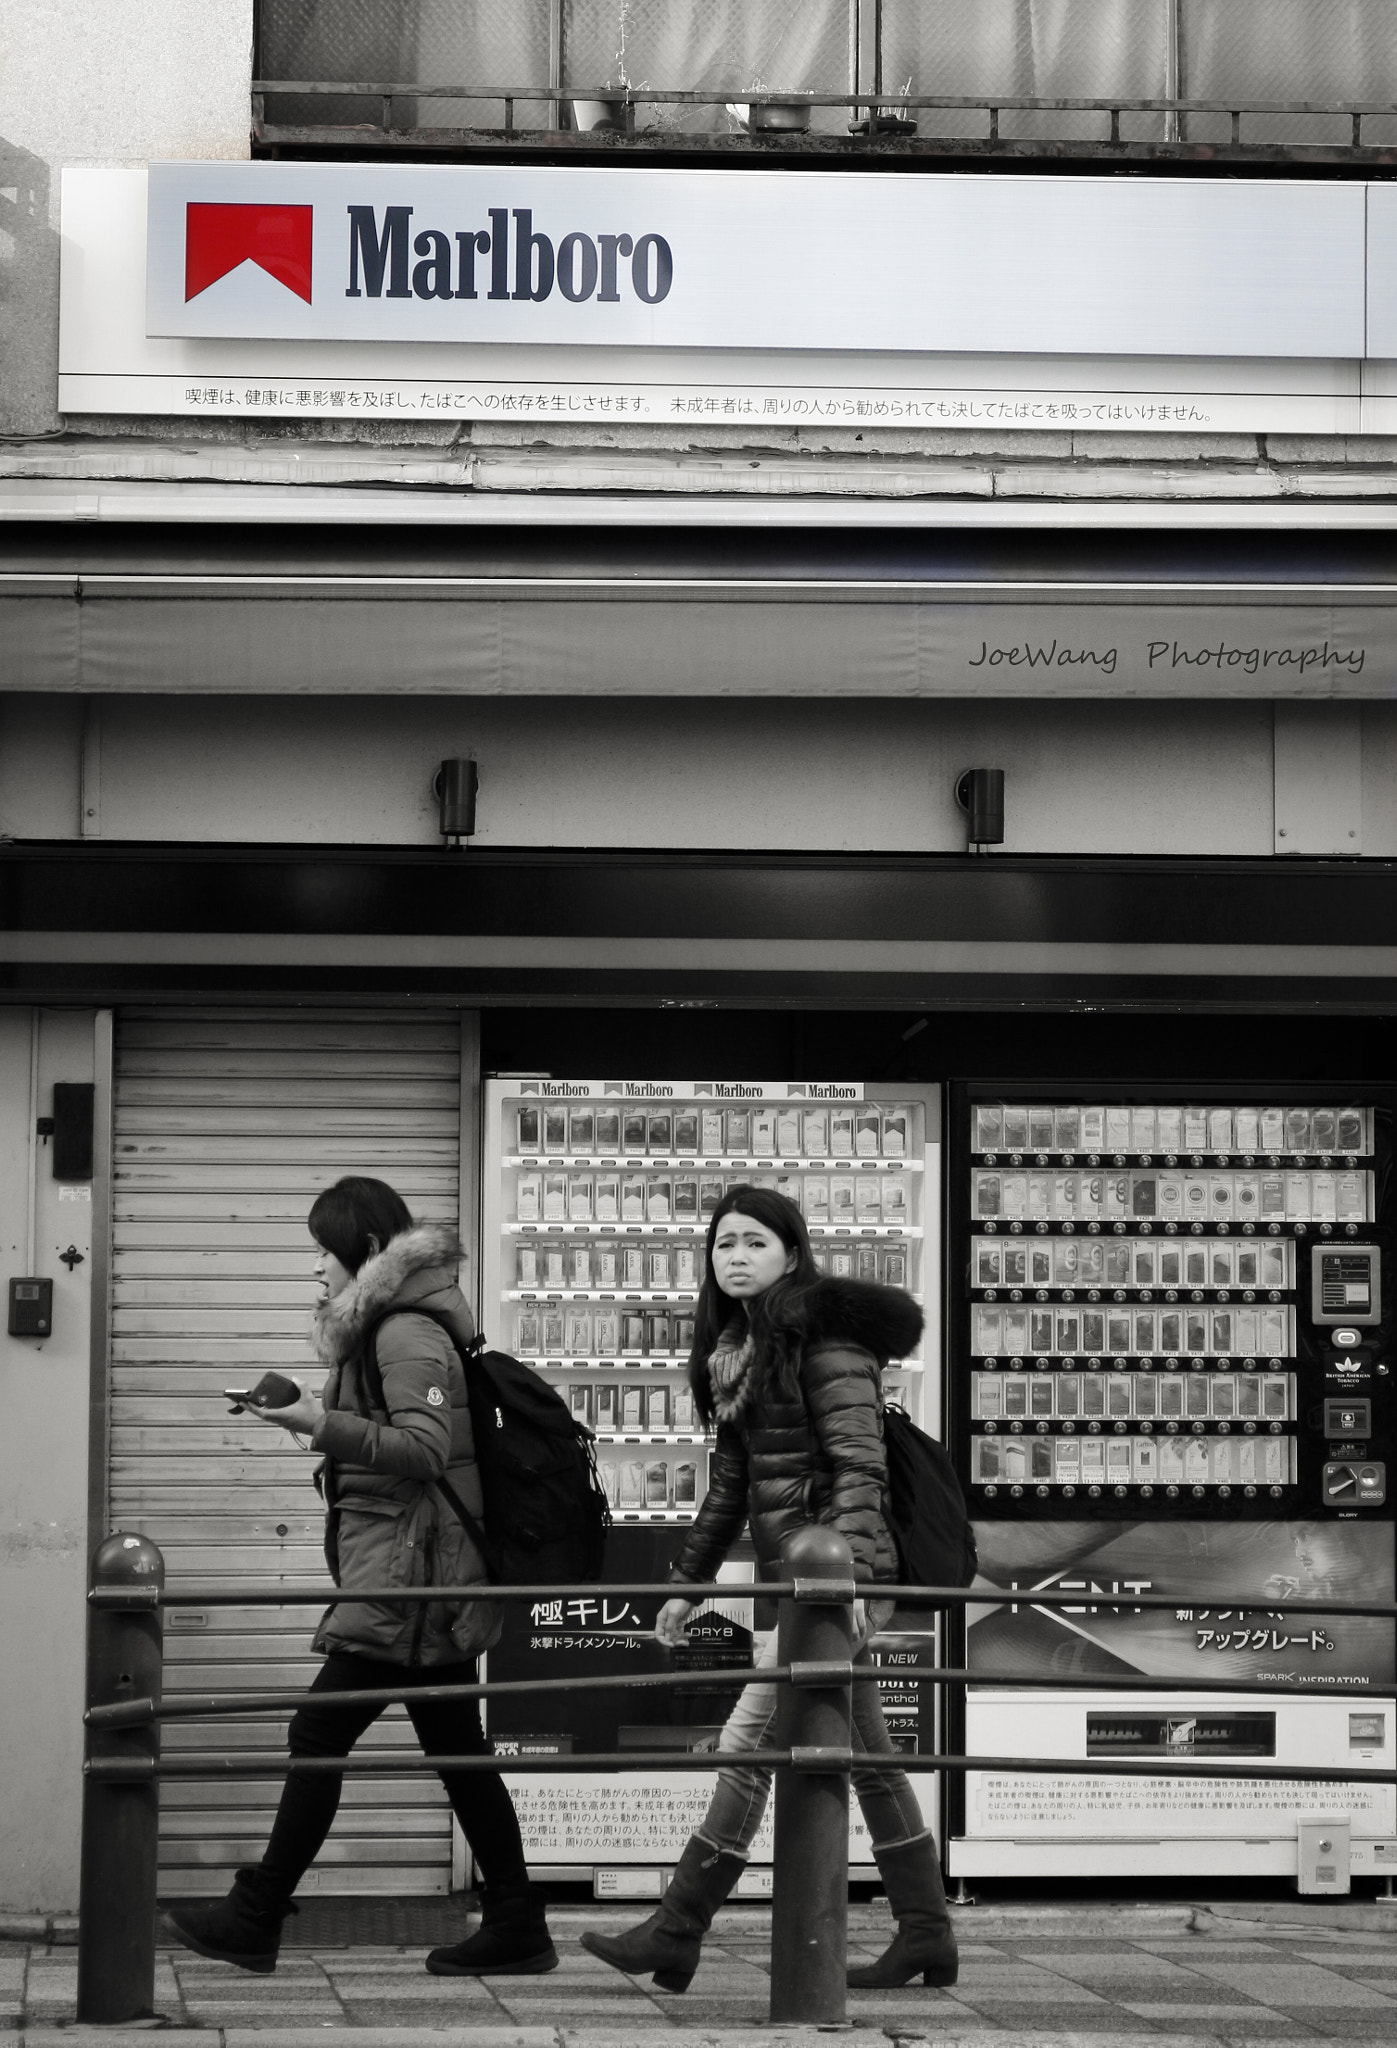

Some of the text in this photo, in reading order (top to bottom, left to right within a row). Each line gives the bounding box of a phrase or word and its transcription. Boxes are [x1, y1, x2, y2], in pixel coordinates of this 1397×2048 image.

[345, 205, 673, 304] Marlboro
[185, 388, 1212, 422] 喫煙は、健康に悪影響を及ぼし、たばこへの依存を生じさせます。 未成年者は、周りの人から勧められても決してたばこを吸ってはいけません。
[541, 1082, 590, 1097] Marlboro
[625, 1083, 673, 1097] Marlboro
[715, 1083, 763, 1098] Marlboro
[808, 1084, 856, 1099] Marlboro
[1011, 1580, 1152, 1614] KENT
[530, 1599, 641, 1627] 極キレ、
[690, 1627, 733, 1637] DRY8
[530, 1636, 641, 1649] 氷撃ドライメンソール。
[1196, 1629, 1335, 1651] アップグレード。
[888, 1653, 919, 1664] NEW
[1257, 1672, 1296, 1682] SPARK
[880, 1694, 919, 1703] enthol
[508, 1787, 715, 1799] 煙は、あなたにとって肺がんの原因の一つとな
[514, 1800, 712, 1811] させる危険性を高めます。未成年者の喫煙
[517, 1813, 707, 1824] 強めます。周りの人から勧められても決して
